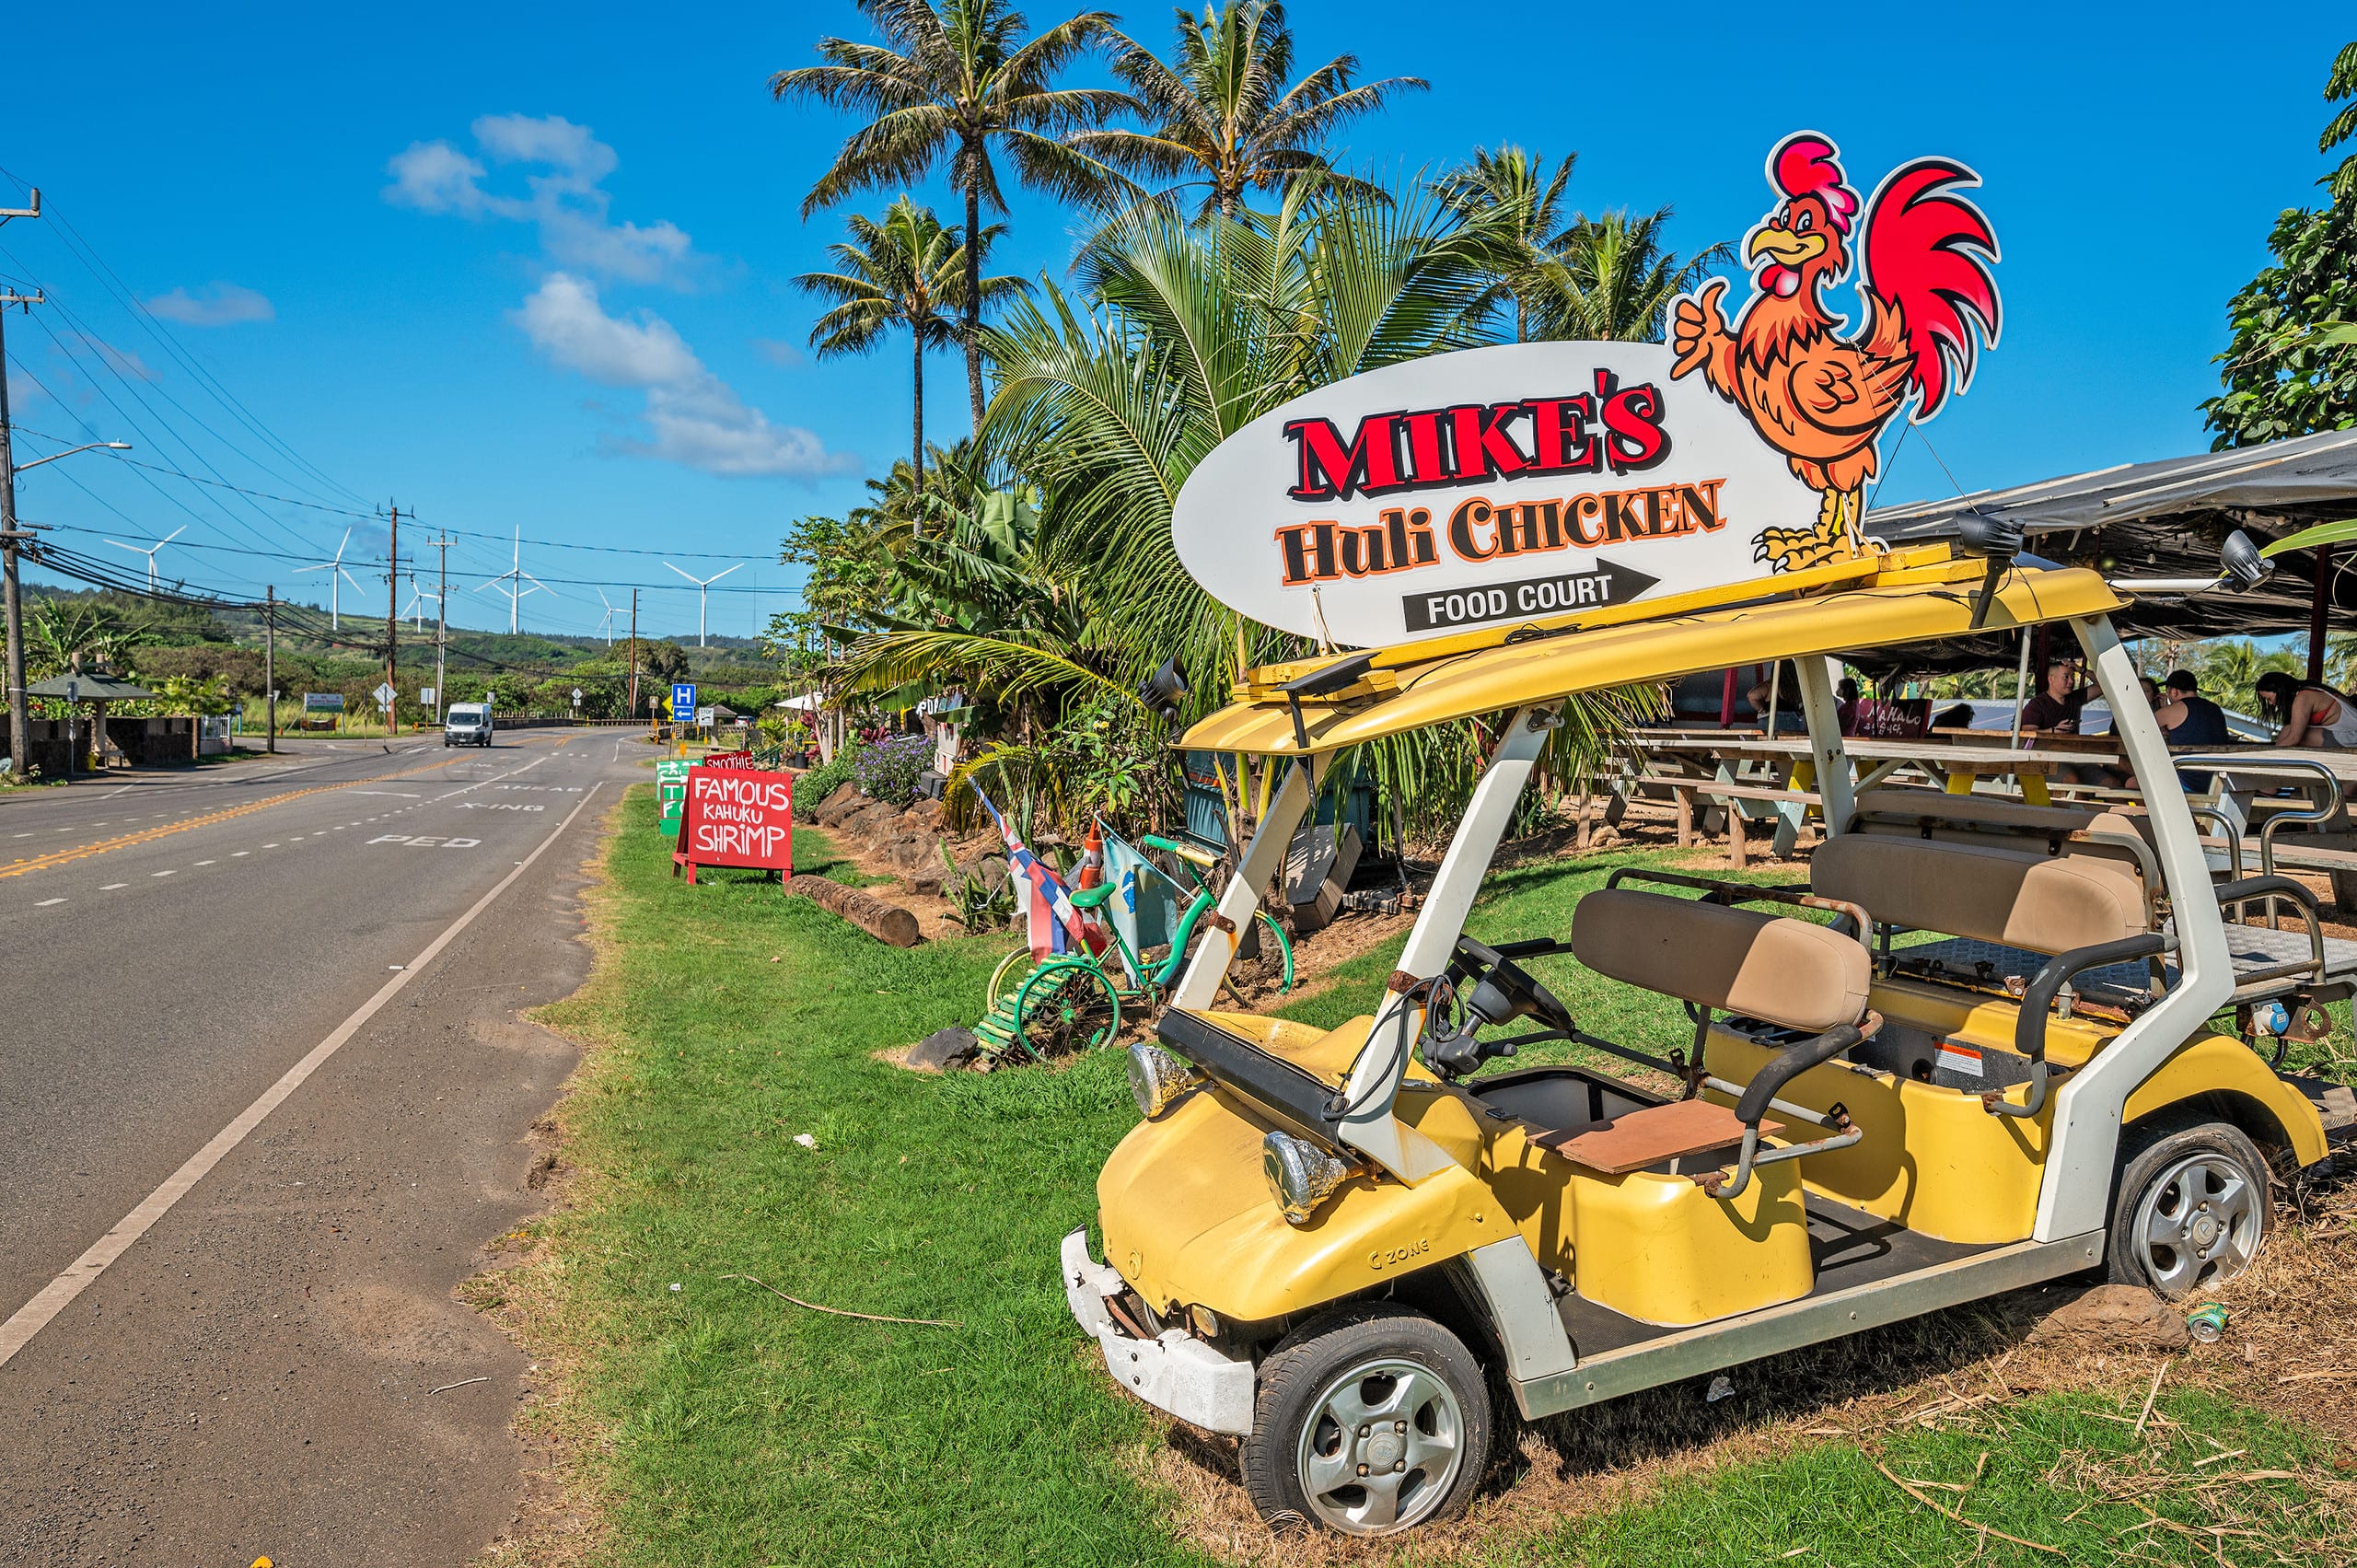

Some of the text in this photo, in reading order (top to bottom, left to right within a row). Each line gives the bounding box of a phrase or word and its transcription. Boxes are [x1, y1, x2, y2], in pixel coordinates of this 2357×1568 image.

[1283, 368, 1671, 501] MIKE'S
[1274, 479, 1727, 586] Huli CHICKEN
[1427, 575, 1612, 623] FOOD COURT
[677, 687, 691, 704] H
[694, 777, 789, 811] FAMOUS
[702, 802, 763, 824] KAHUKU
[366, 834, 482, 848] PED
[1368, 1237, 1430, 1271] C ZONE
